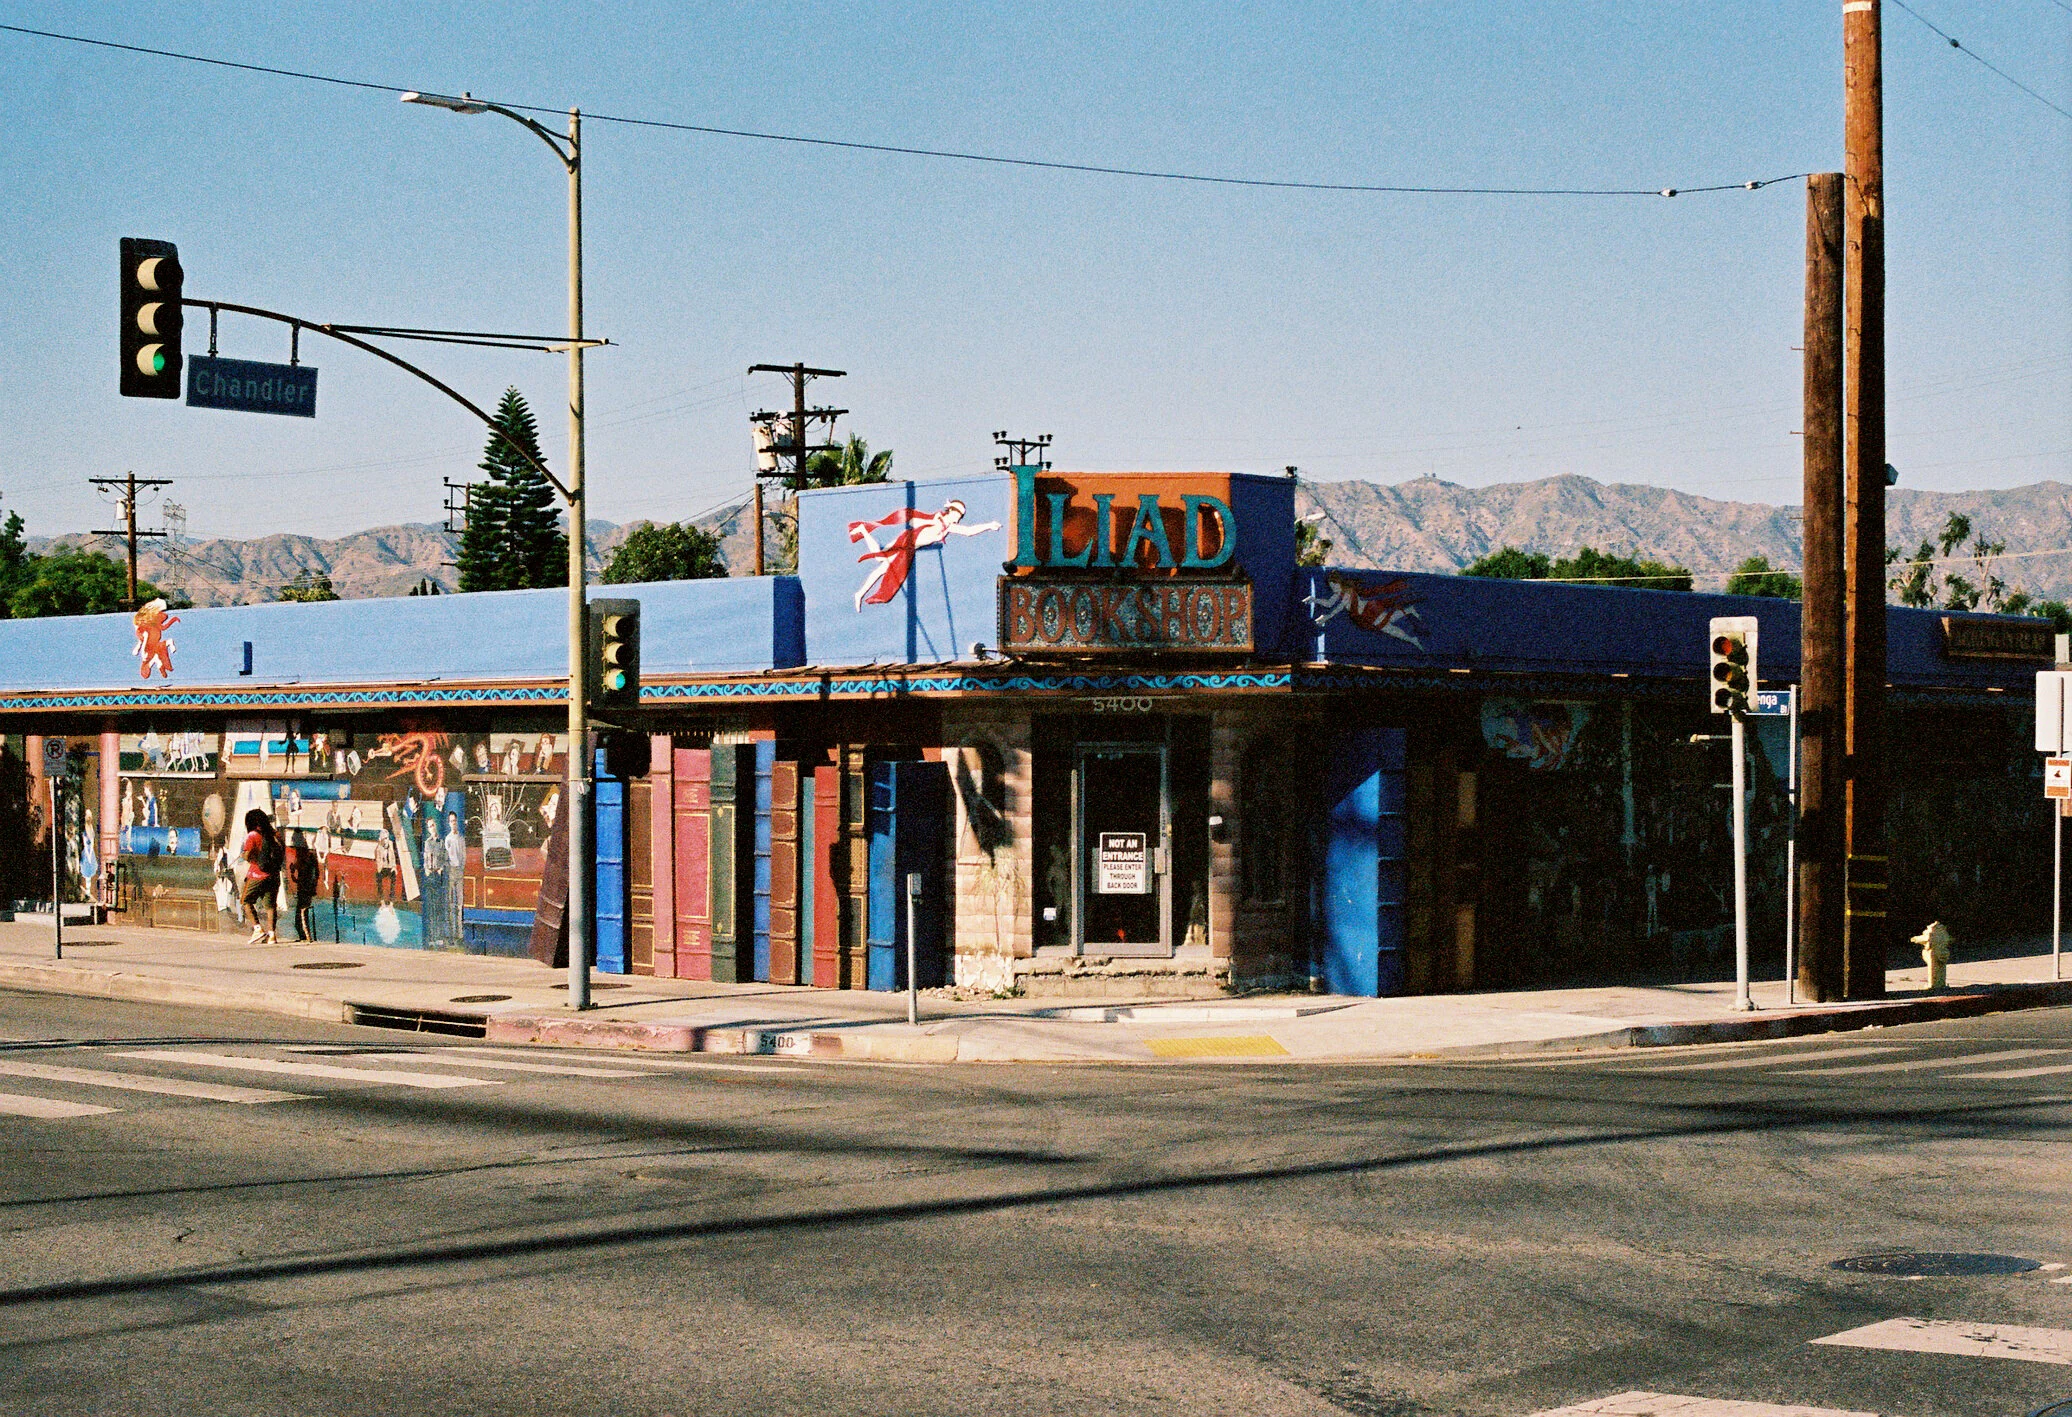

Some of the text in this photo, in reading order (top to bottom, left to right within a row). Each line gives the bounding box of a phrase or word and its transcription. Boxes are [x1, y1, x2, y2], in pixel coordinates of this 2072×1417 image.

[195, 368, 309, 403] Chandler
[1010, 465, 1237, 568] ILIAD
[1009, 587, 1248, 643] BOOKSHOP
[1093, 696, 1153, 711] 5400
[1108, 838, 1138, 848] NOT AN
[1102, 851, 1144, 860] ENTRANCE
[1103, 863, 1142, 871] PLEASE ENTER
[760, 1033, 794, 1048] 5400
